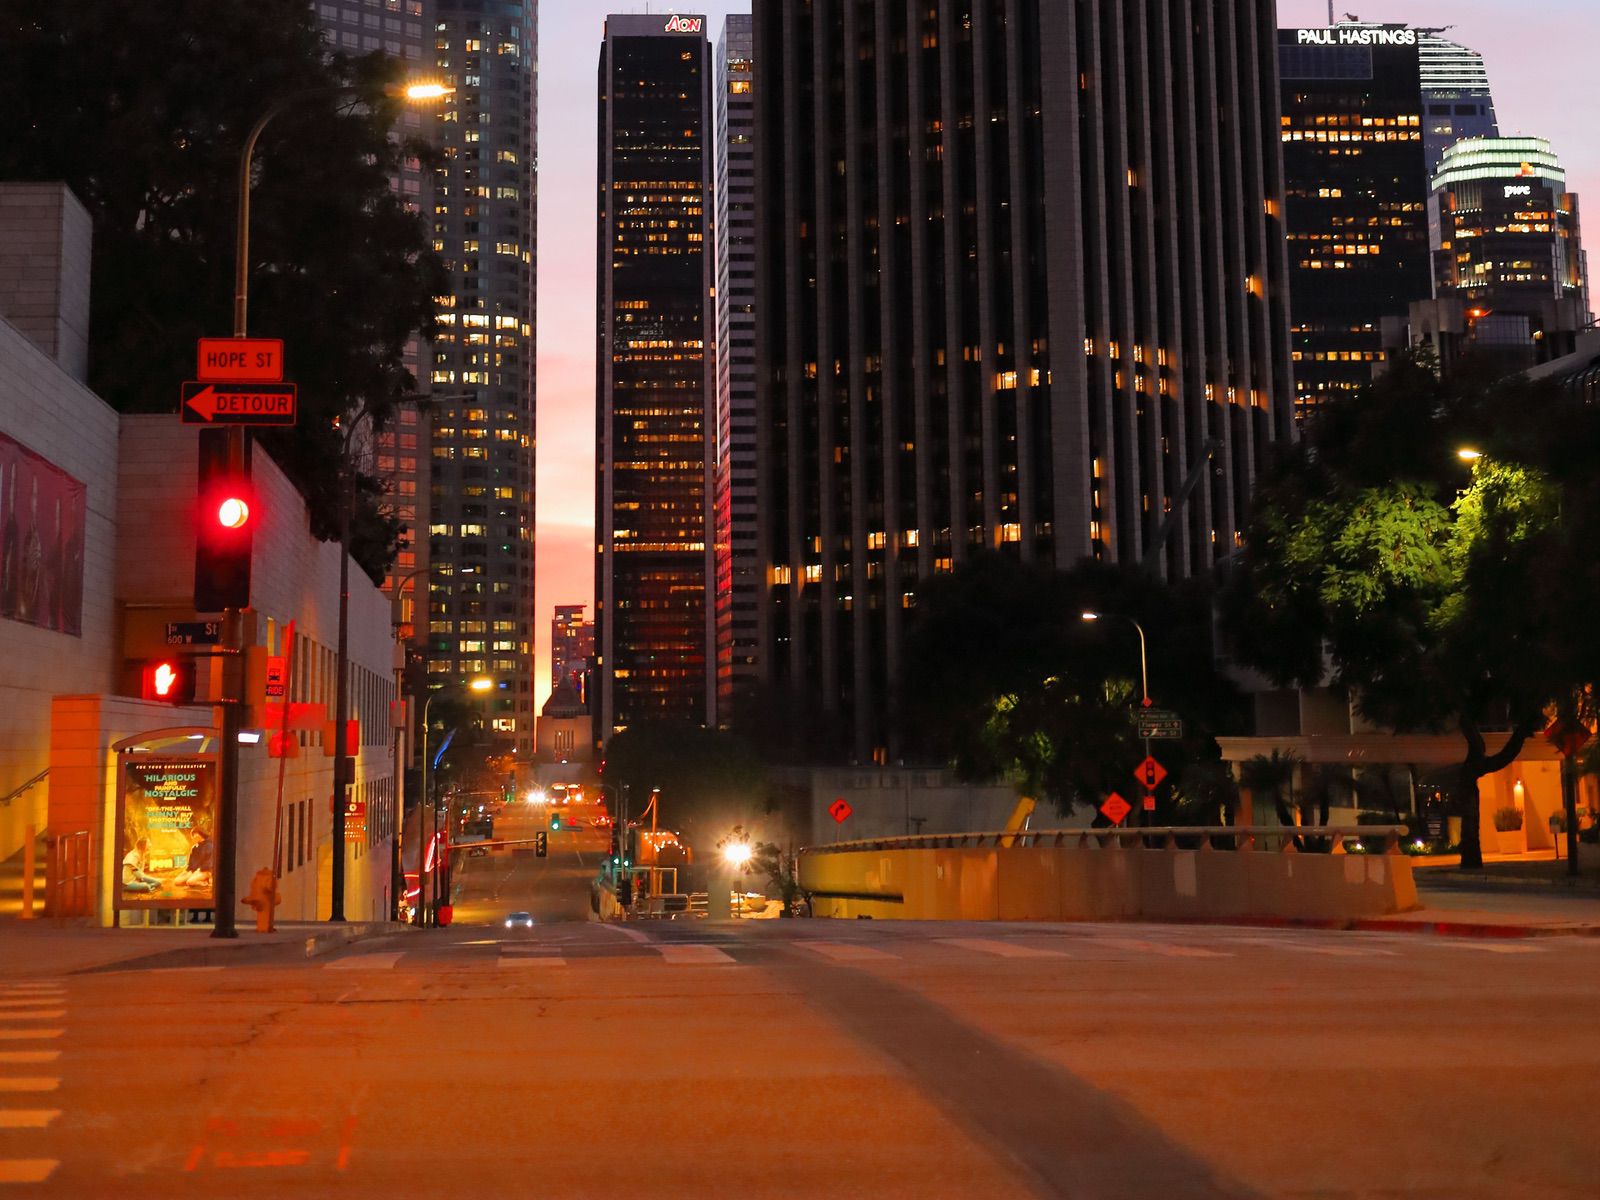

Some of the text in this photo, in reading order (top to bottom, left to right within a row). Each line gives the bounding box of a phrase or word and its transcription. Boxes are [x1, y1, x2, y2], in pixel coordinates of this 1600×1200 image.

[1297, 29, 1416, 46] PAUL HASTINGS
[1503, 185, 1531, 198] pwc
[207, 352, 273, 368] HOPE ST
[216, 396, 288, 412] DETOUR
[205, 623, 217, 635] St
[167, 635, 193, 644] 600 W
